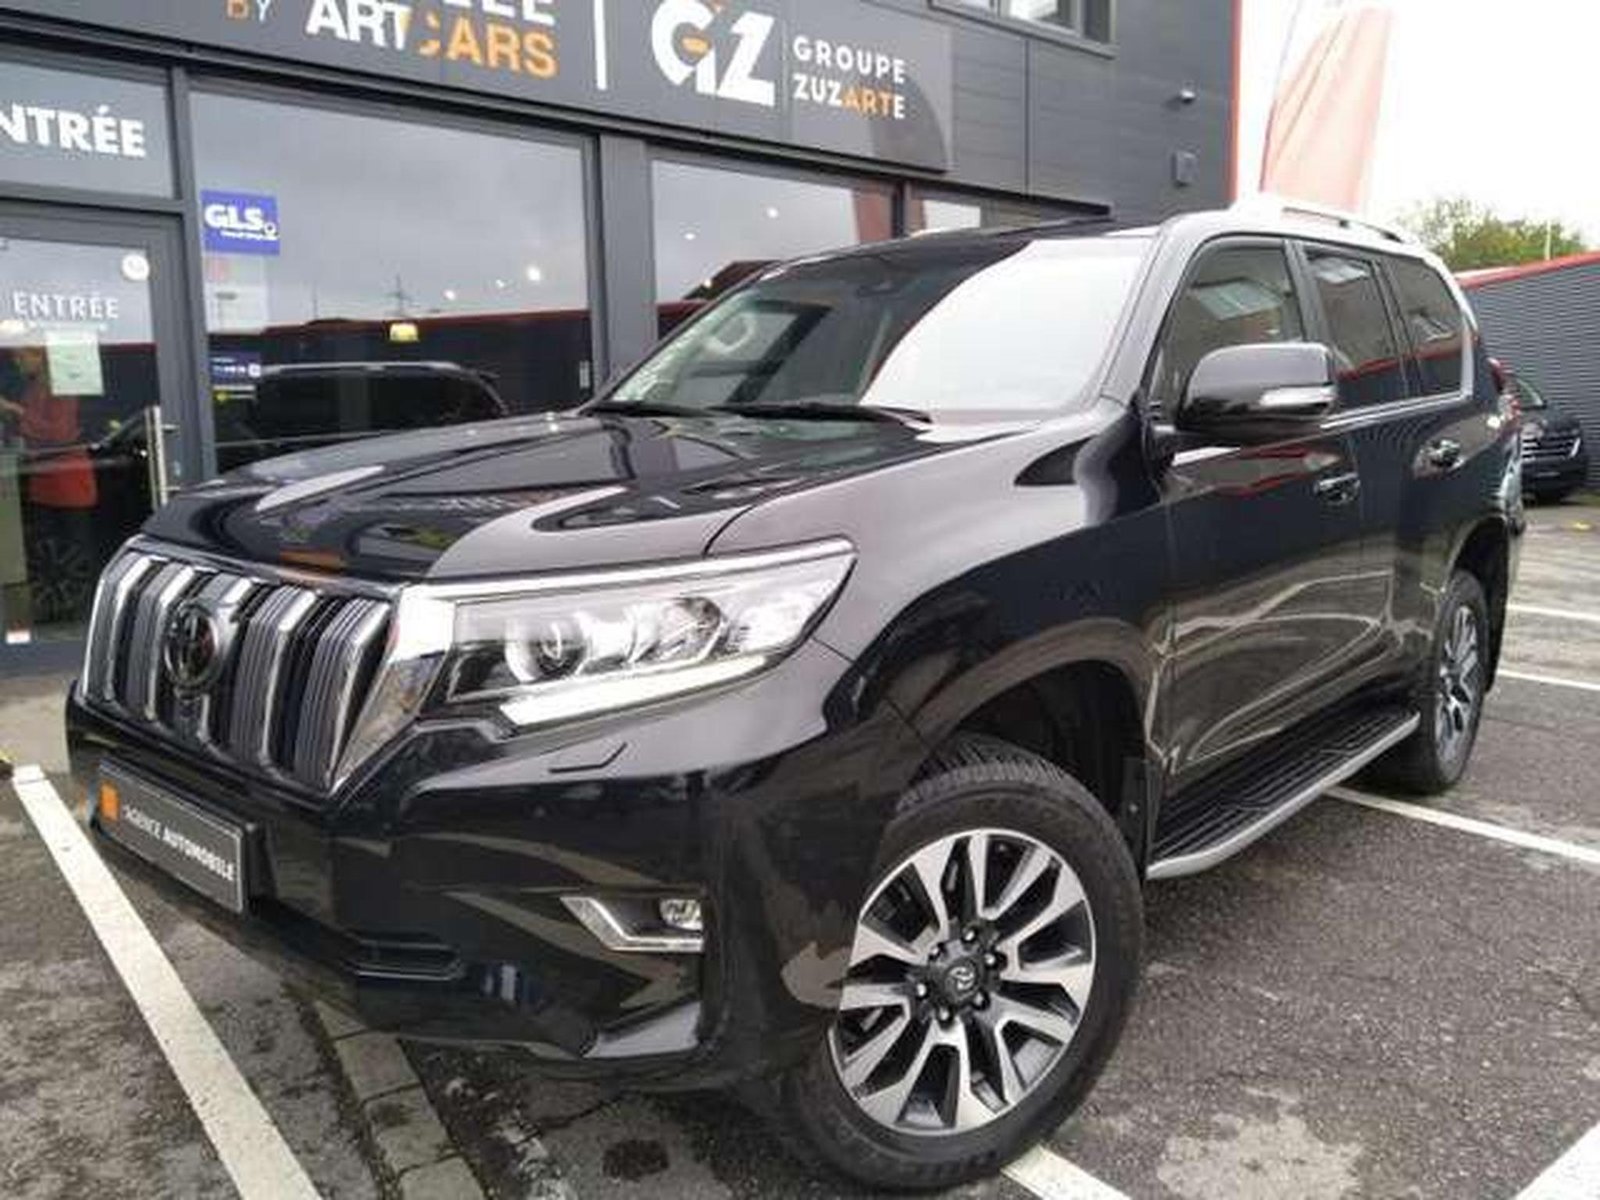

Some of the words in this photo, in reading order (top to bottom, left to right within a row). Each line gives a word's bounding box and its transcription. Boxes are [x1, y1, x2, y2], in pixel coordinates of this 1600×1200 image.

[792, 36, 906, 84] GROUPE
[793, 74, 906, 119] ZUZARTE
[204, 203, 264, 231] GLS
[13, 290, 120, 320] ENTRÉE
